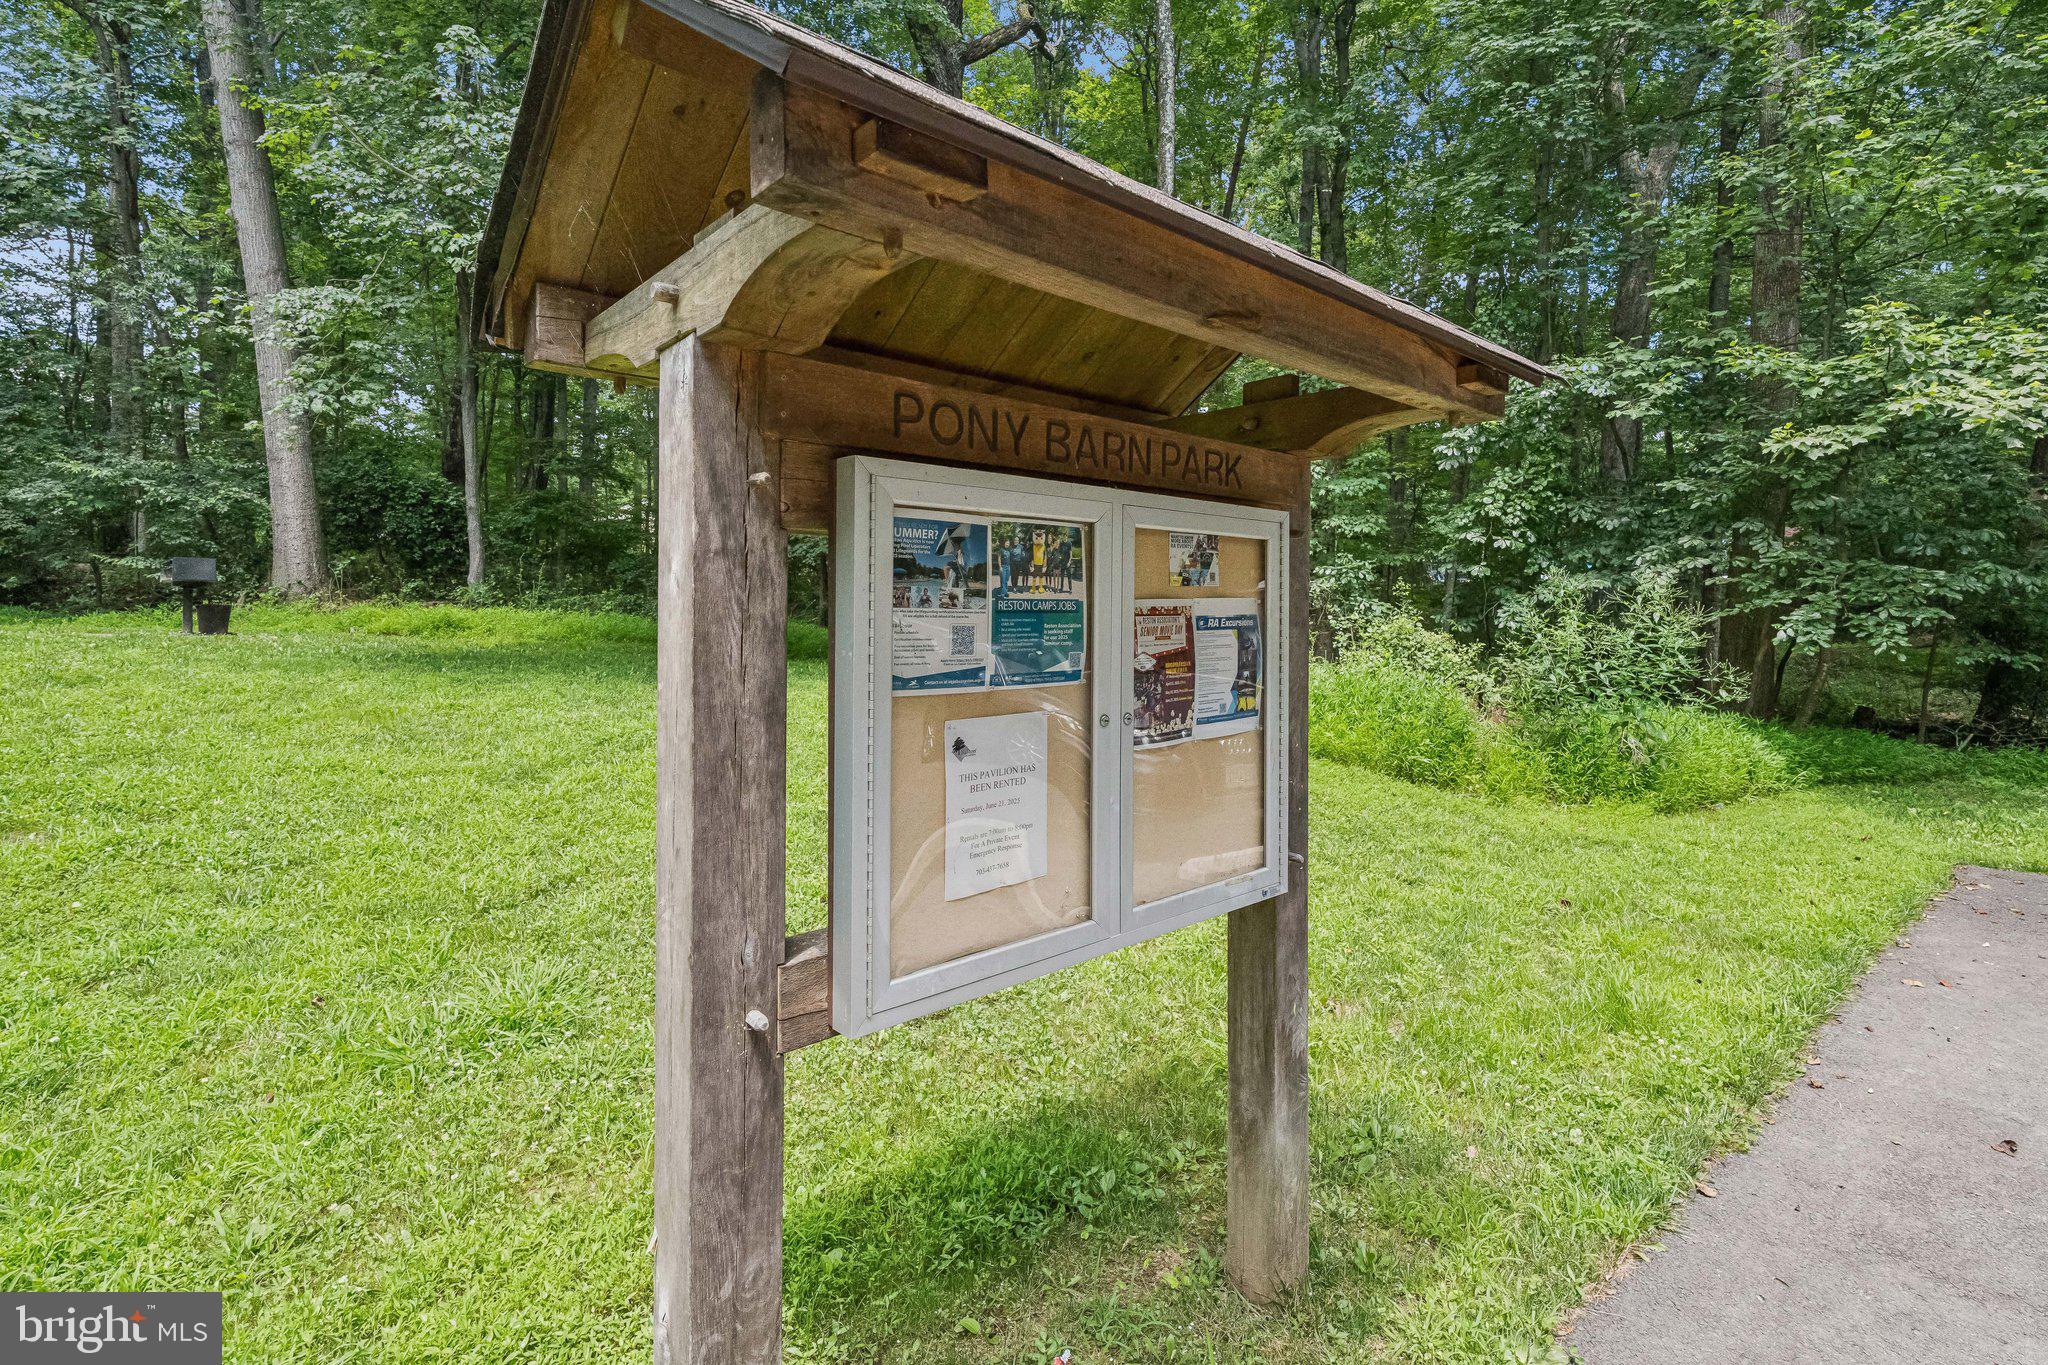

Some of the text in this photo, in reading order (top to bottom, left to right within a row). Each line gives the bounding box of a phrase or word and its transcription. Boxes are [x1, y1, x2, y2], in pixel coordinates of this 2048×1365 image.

[893, 389, 1243, 489] PONY BARN PARK
[998, 600, 1077, 611] RESTON CAMPS JOBS
[1208, 618, 1254, 628] RA Excursions
[959, 762, 1036, 783] THIS PAVILION HAS
[970, 776, 1027, 793] BEEN RENTED
[985, 802, 997, 810] June
[1007, 797, 1021, 806] 2025
